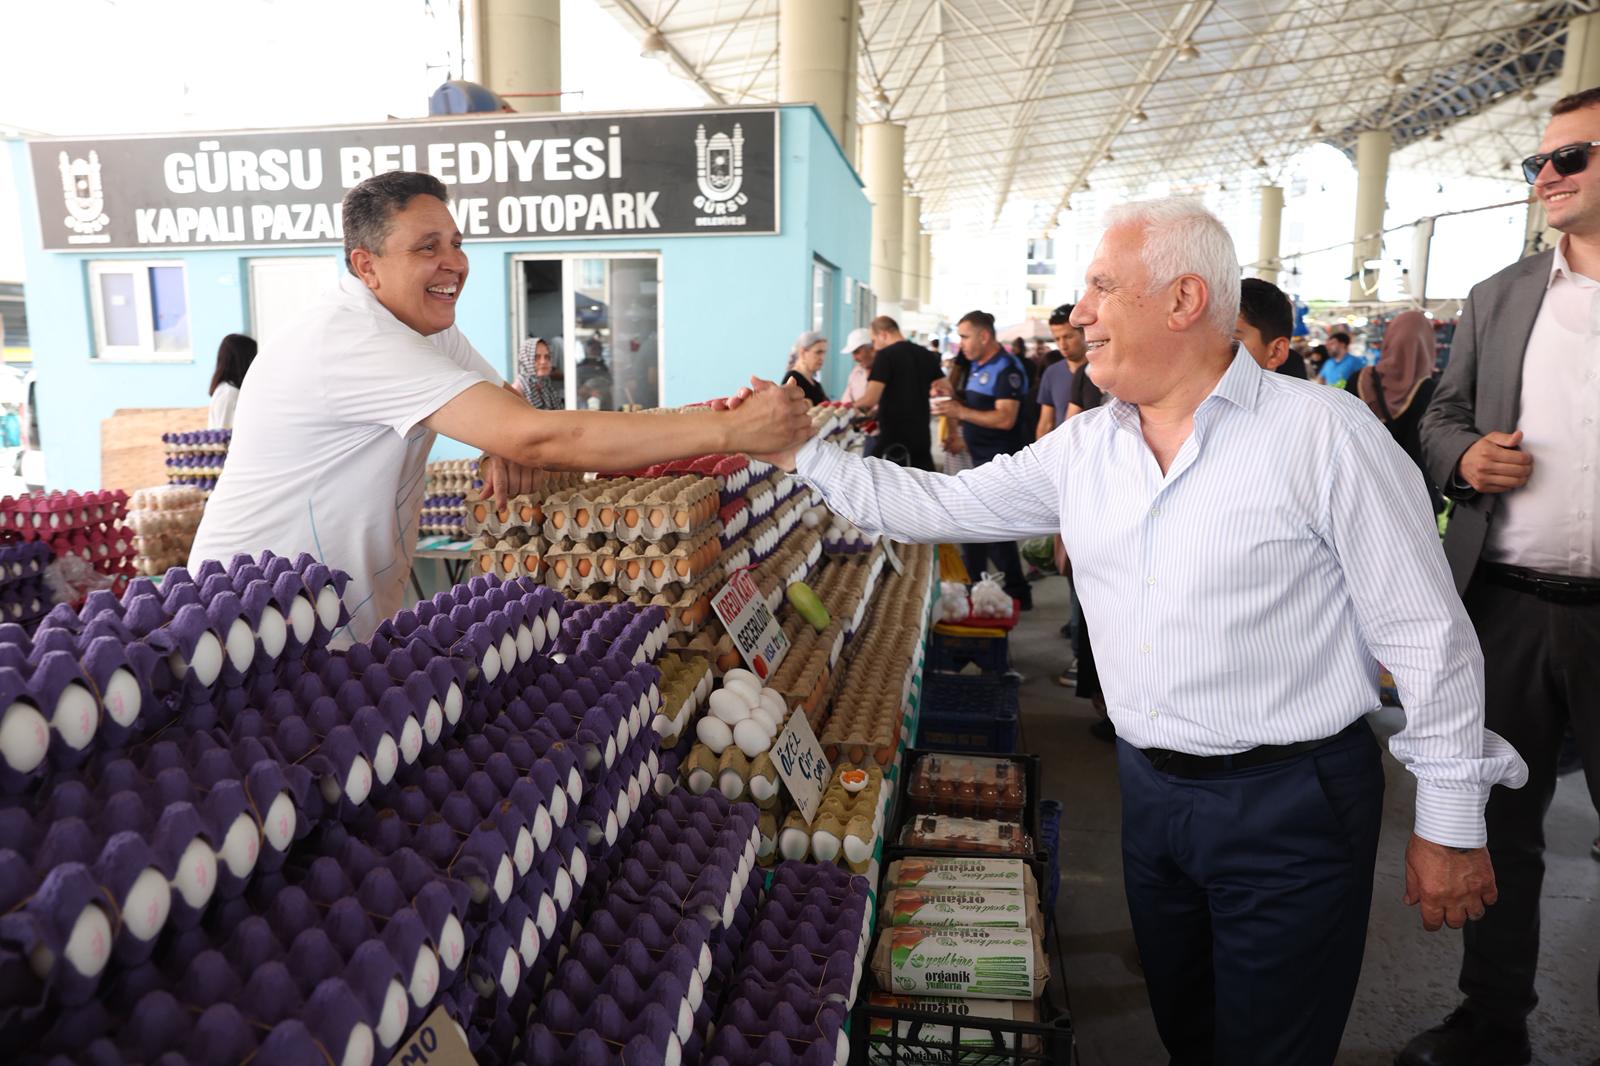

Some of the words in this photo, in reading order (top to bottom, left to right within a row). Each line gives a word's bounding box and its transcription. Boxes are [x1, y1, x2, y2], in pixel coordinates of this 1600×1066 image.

[163, 140, 323, 194] GÜRSU
[135, 206, 245, 243] KAPALI
[446, 198, 490, 235] VE
[498, 191, 660, 234] OTOPARK
[737, 601, 772, 653] GEÇERLİDİR
[777, 732, 801, 776] ÖZEL
[925, 971, 970, 983] organik
